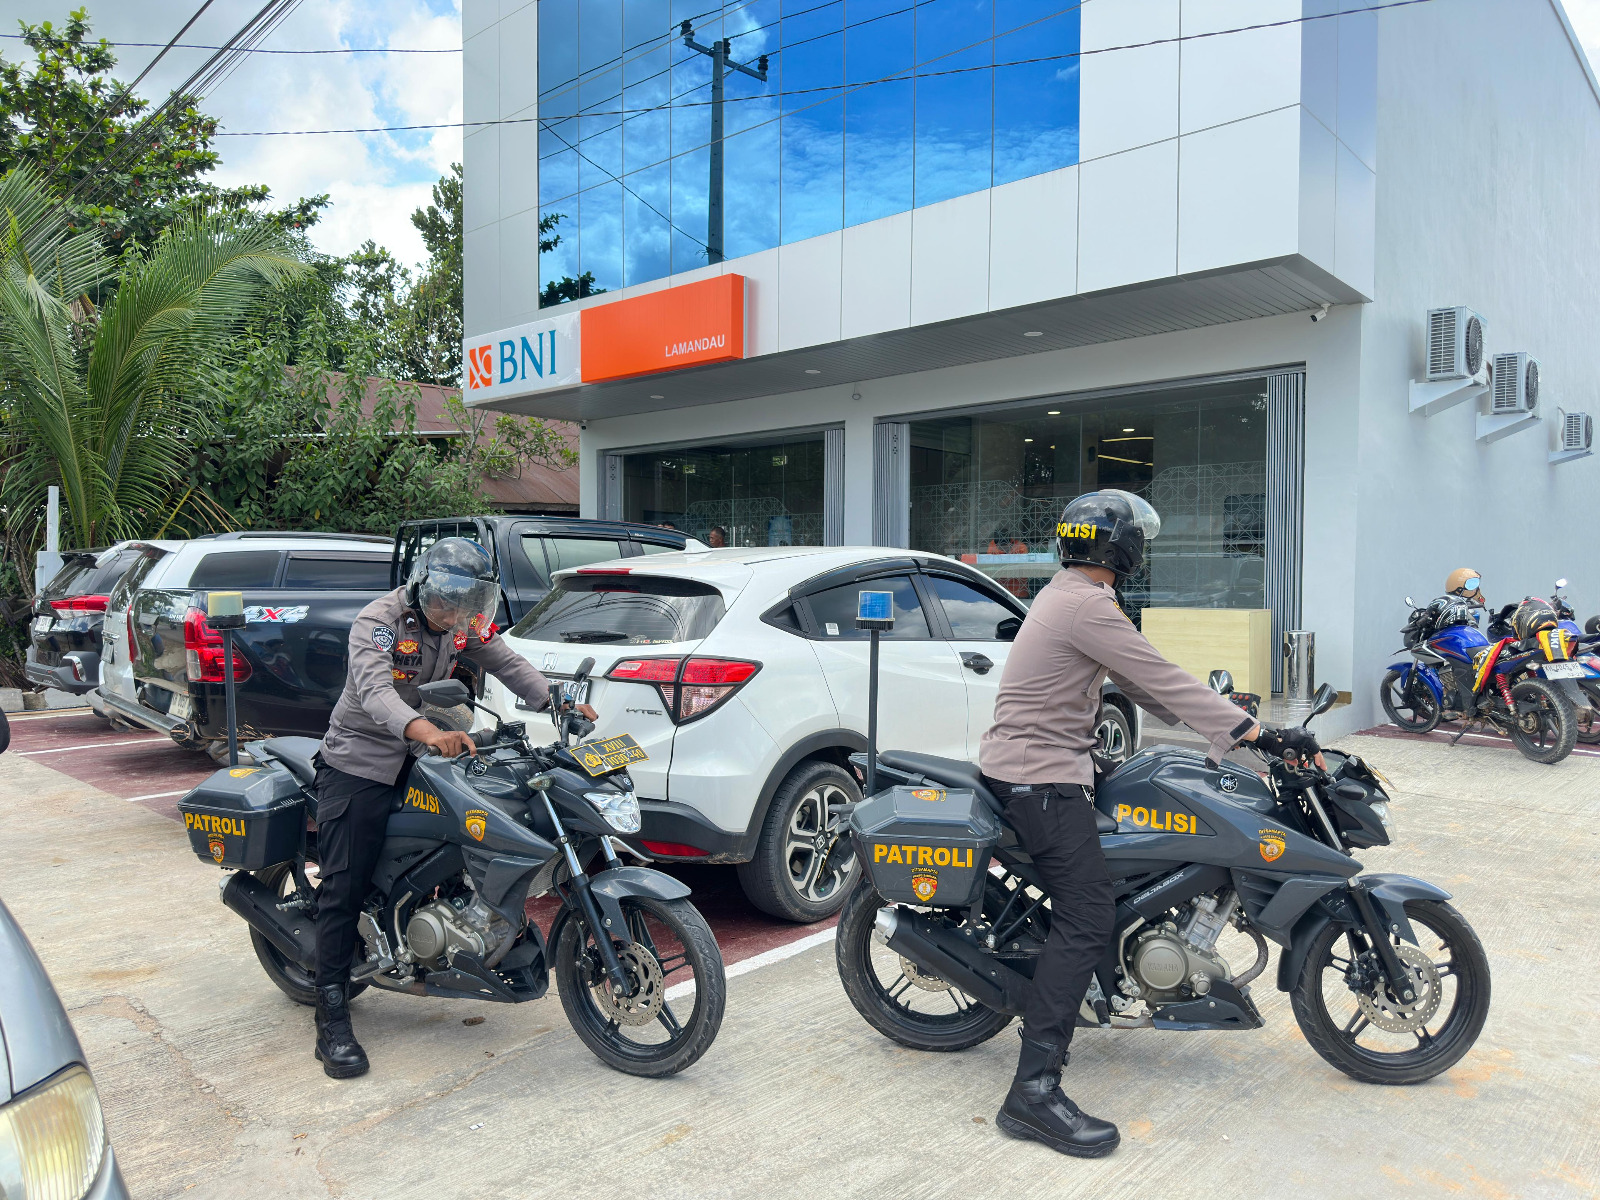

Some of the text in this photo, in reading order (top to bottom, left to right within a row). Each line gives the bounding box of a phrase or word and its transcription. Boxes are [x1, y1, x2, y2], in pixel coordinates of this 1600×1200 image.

[498, 329, 558, 385] BNI
[665, 334, 726, 358] LAMANDAU
[1056, 522, 1097, 540] POLISI
[601, 738, 627, 753] XVIII
[404, 786, 440, 815] POLISI
[184, 812, 247, 837] PATROLI
[1116, 803, 1197, 835] POLISI
[873, 843, 974, 868] PATROLI
[1133, 871, 1185, 905] DELTABOX
